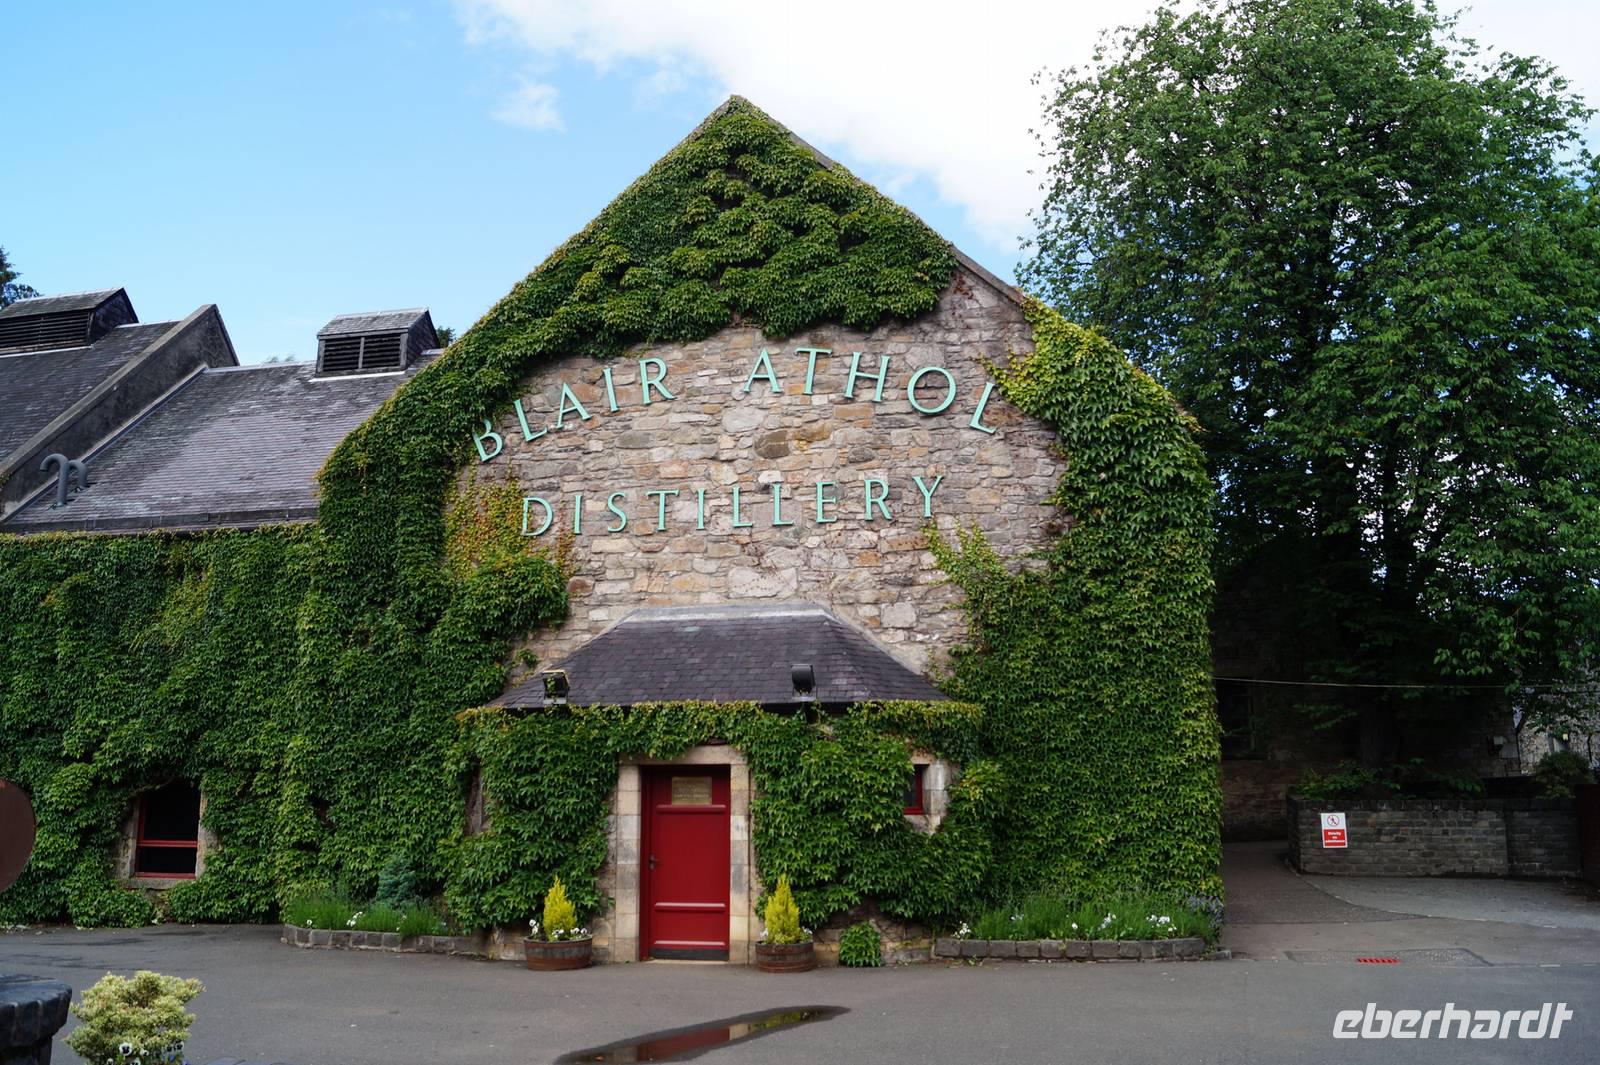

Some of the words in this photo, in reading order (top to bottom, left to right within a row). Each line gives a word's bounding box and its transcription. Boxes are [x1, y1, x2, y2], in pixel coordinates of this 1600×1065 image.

[473, 357, 677, 462] BLAIR
[743, 347, 997, 434] ATHOL
[521, 475, 944, 536] DISTILLERY
